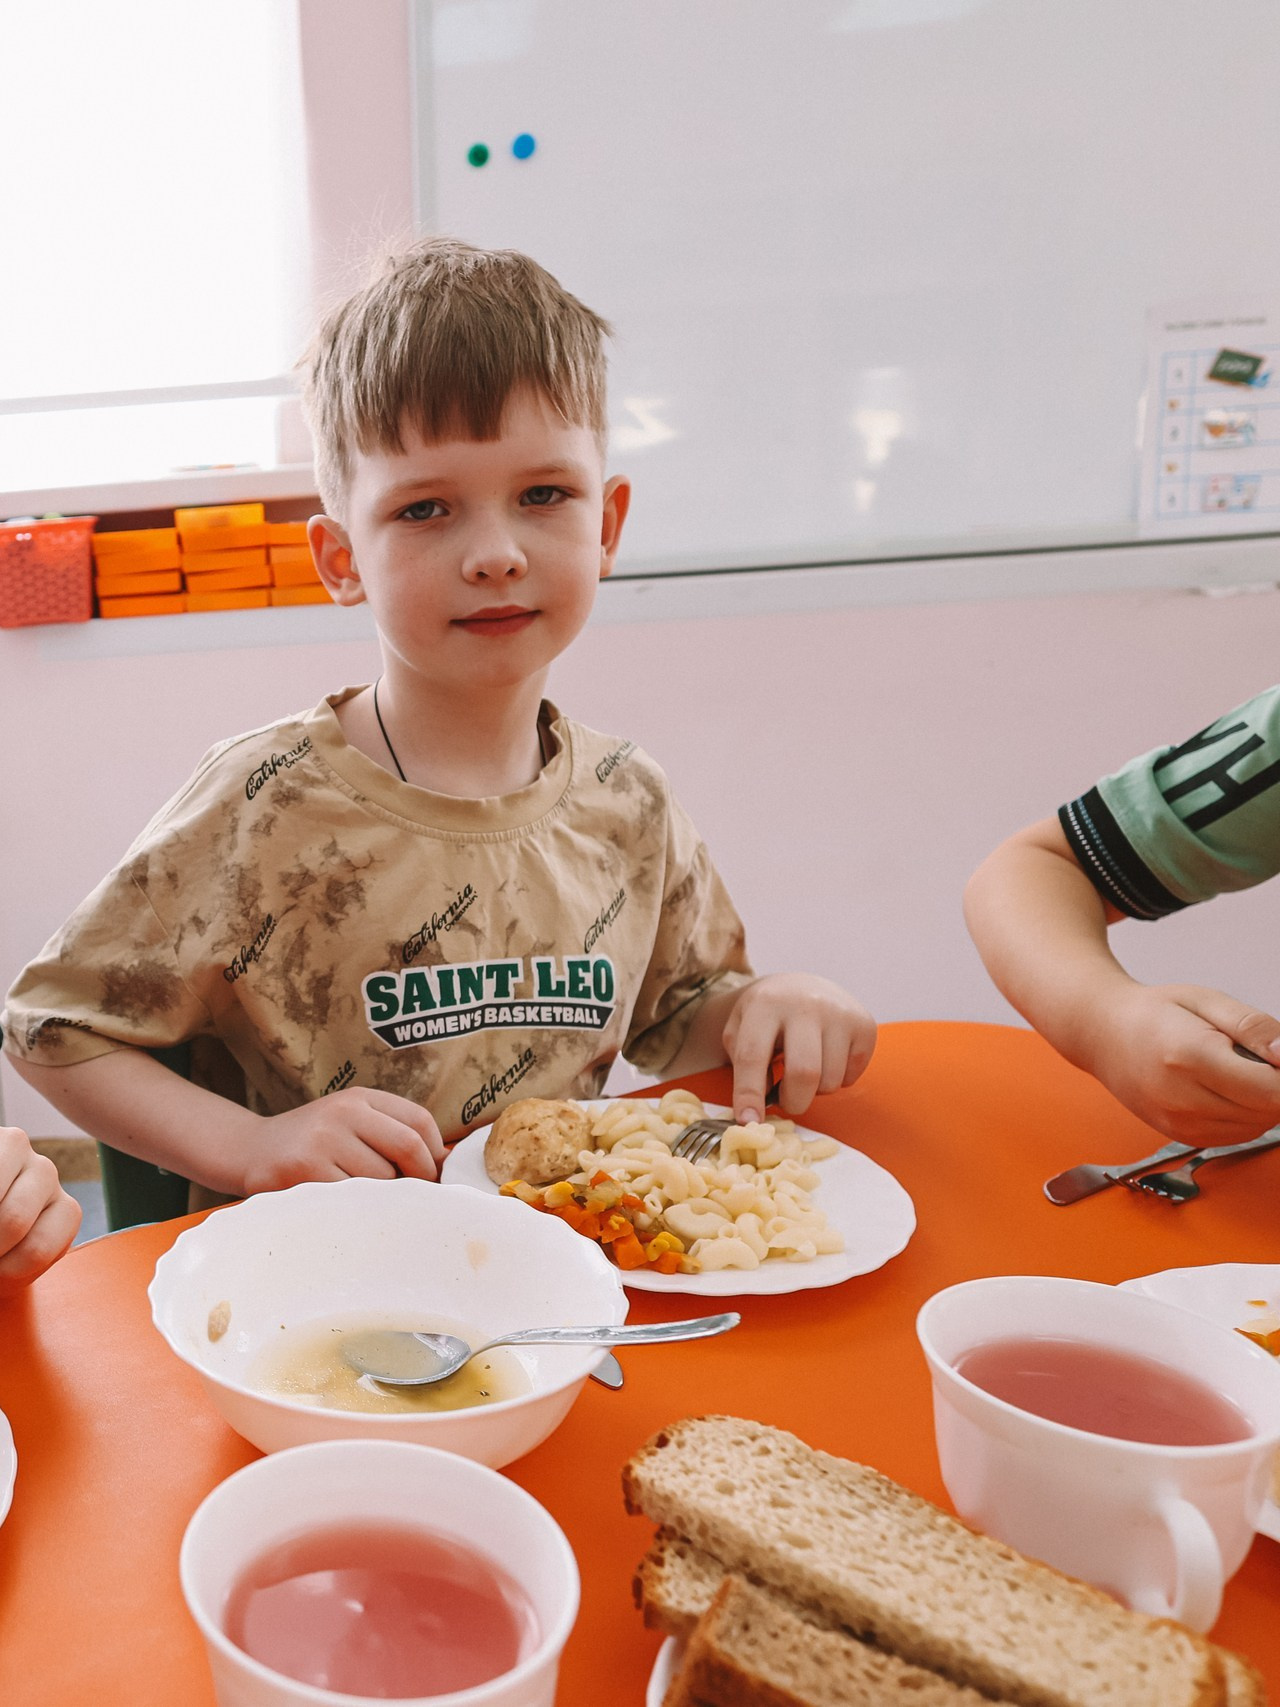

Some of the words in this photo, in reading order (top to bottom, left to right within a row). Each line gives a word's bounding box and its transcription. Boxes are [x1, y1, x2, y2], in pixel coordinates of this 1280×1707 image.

[245, 735, 312, 800] California
[402, 883, 473, 964] California
[584, 887, 625, 954] California
[366, 963, 519, 1022] SAINT
[536, 959, 614, 1002] LEO
[394, 1010, 482, 1043] WOMEN'S
[484, 1006, 602, 1025] BASKETBALL
[462, 1047, 533, 1125] California
